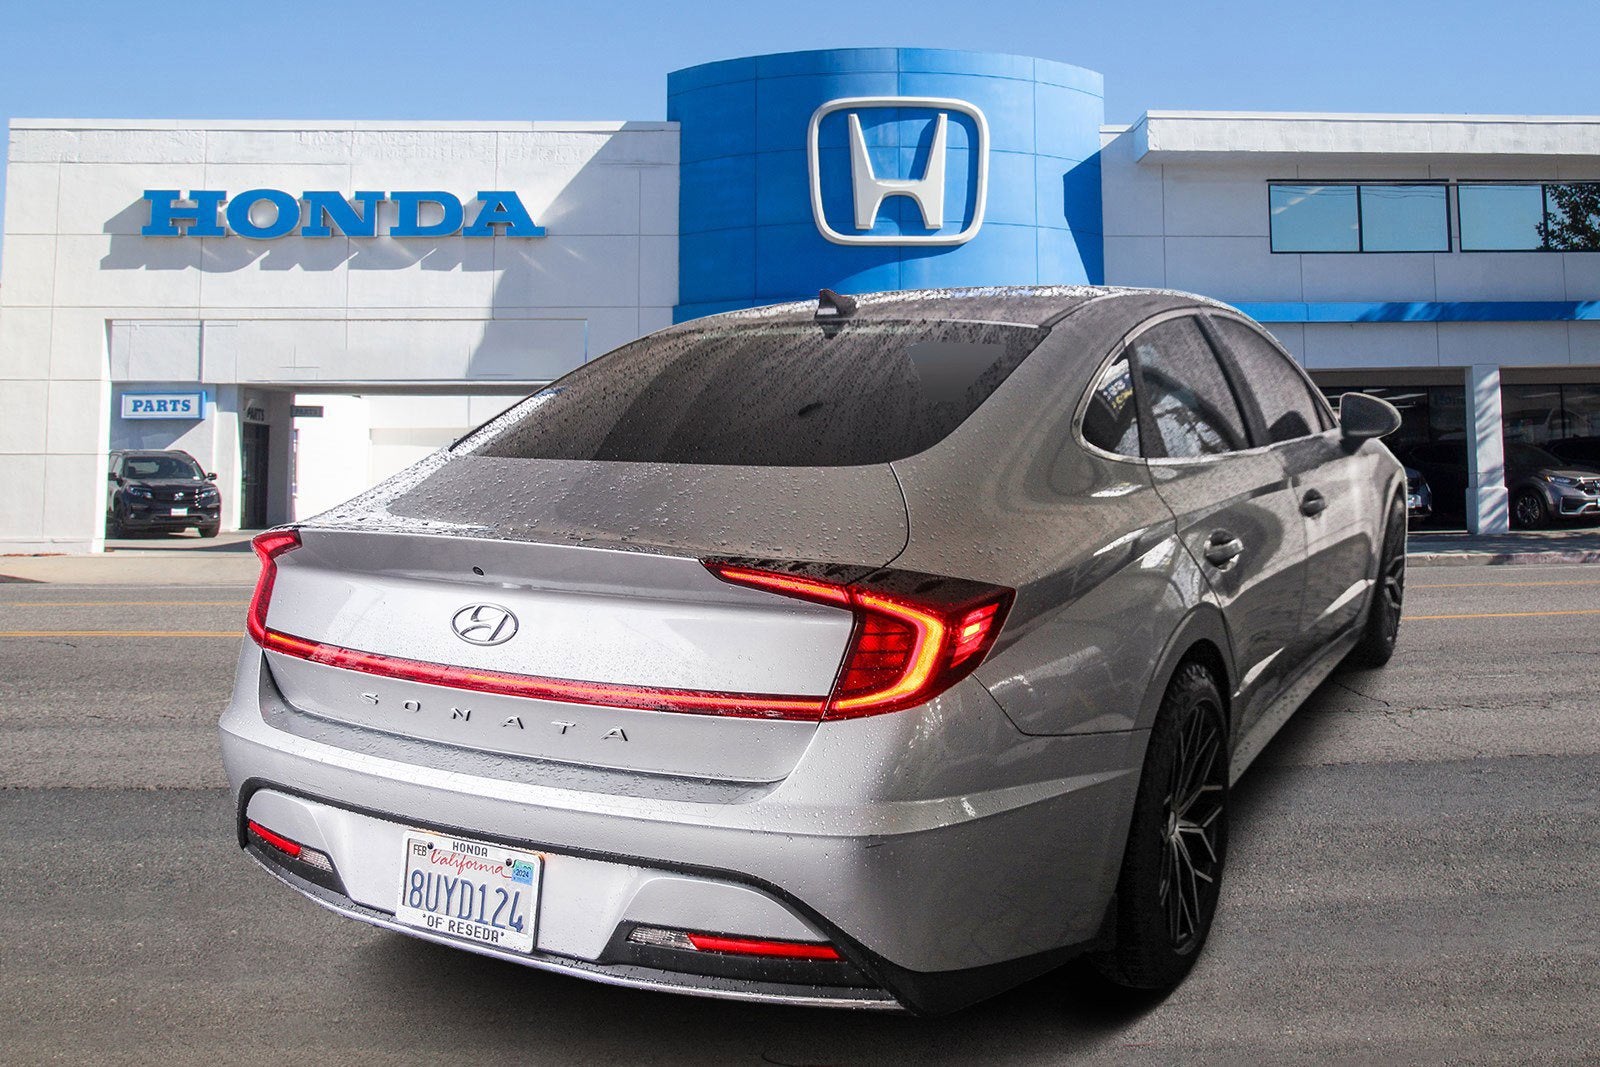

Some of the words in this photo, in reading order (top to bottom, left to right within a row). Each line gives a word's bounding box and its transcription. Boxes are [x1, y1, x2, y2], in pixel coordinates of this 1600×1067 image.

[141, 189, 548, 240] HONDA
[131, 399, 192, 412] PARTS
[360, 692, 628, 742] SONATA
[413, 844, 427, 857] FEB
[452, 841, 488, 857] HONDA
[430, 848, 511, 879] California
[514, 868, 530, 878] 2024
[409, 869, 523, 933] 8UYD124
[427, 915, 443, 929] OF
[448, 920, 500, 943] RESEDA
